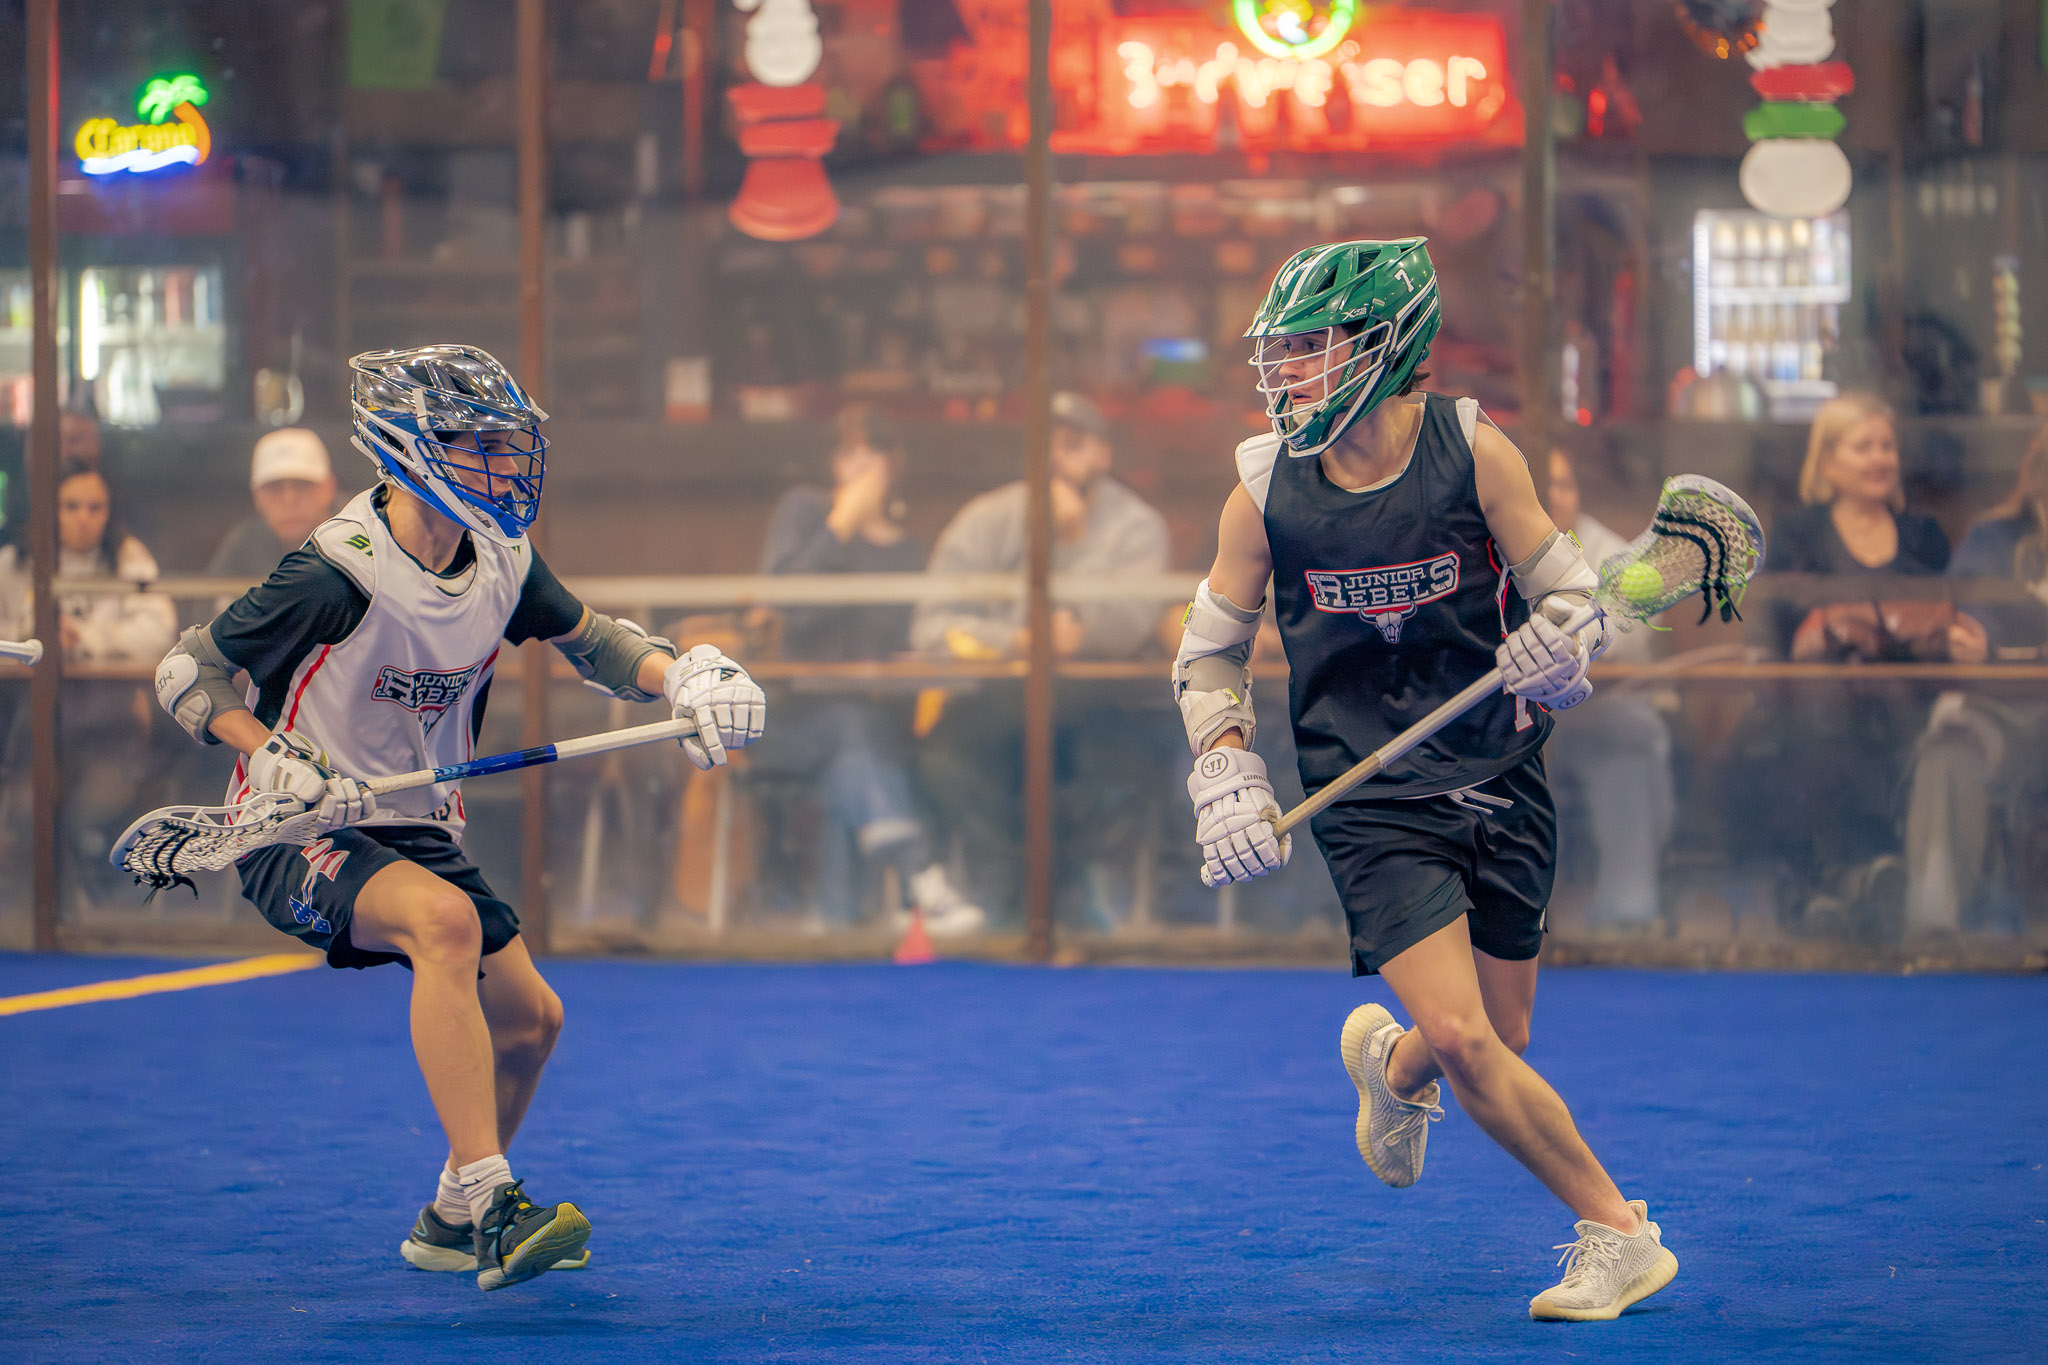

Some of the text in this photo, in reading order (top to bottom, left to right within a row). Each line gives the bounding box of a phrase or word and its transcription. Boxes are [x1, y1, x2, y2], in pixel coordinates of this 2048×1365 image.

[1394, 268, 1414, 293] 7
[1309, 556, 1456, 608] REBELS
[1344, 566, 1426, 589] JUNIOR
